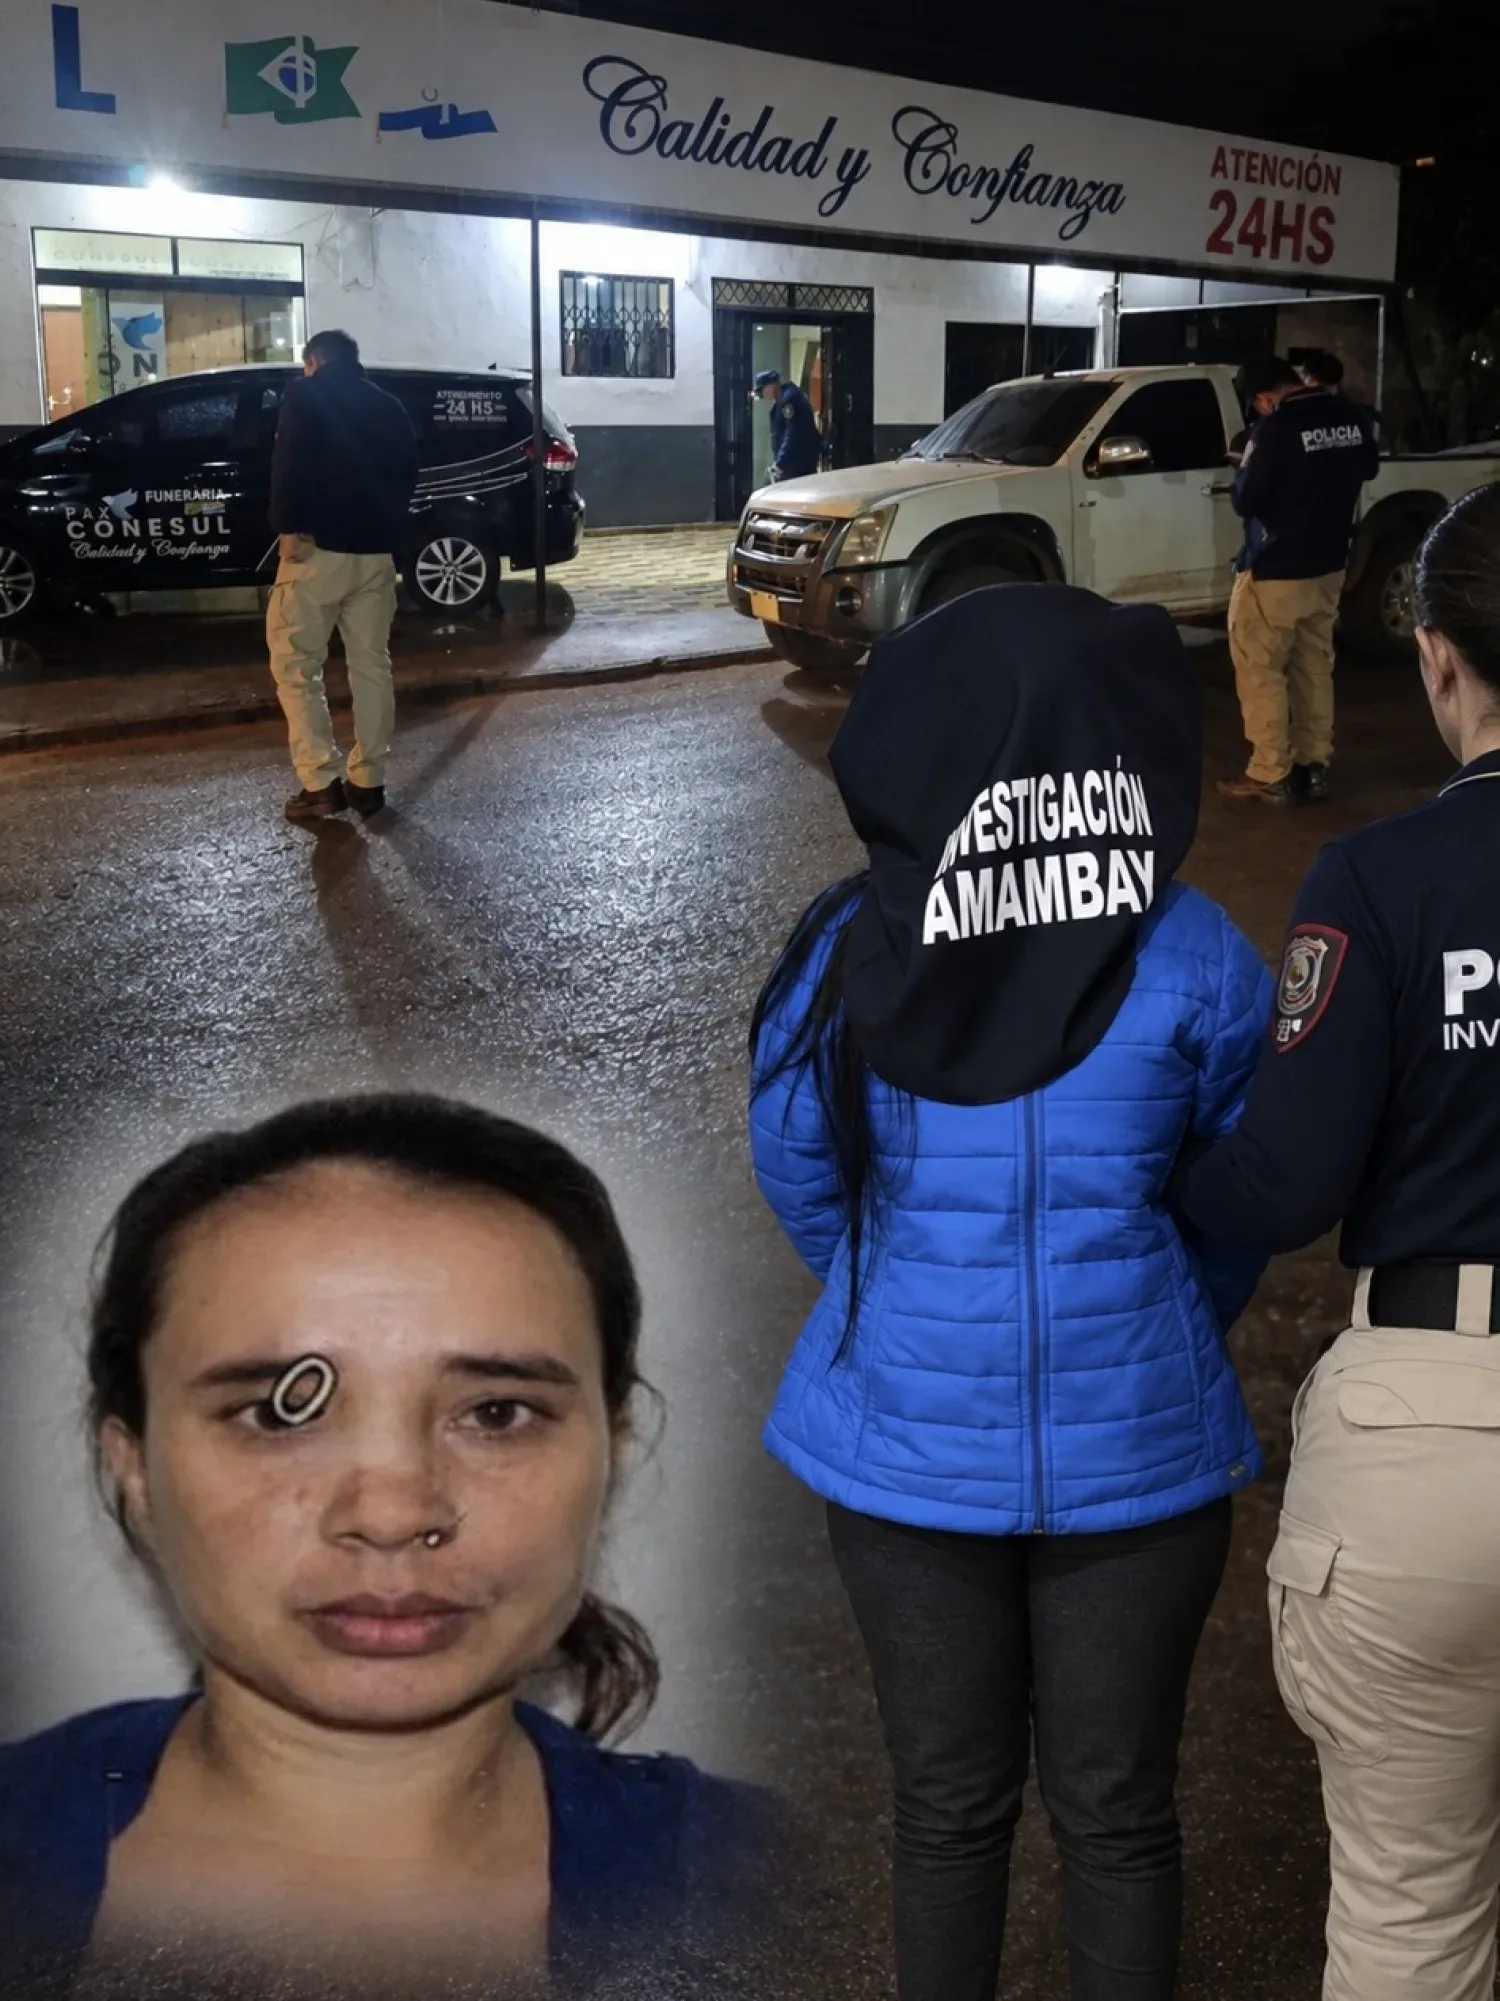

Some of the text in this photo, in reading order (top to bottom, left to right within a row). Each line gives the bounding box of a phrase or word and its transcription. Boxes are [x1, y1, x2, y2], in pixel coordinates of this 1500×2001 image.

[52, 4, 116, 114] L
[583, 55, 1127, 240] Calidad y Confianza
[1210, 145, 1342, 195] ATENCIÓN
[1206, 189, 1336, 265] 24HS
[65, 506, 109, 520] PAX
[66, 515, 231, 539] CONESUL
[69, 538, 230, 564] Calidad y Confianza
[922, 848, 1154, 944] AMAMBAY
[1443, 948, 1500, 1016] P
[1443, 1018, 1500, 1051] INV
